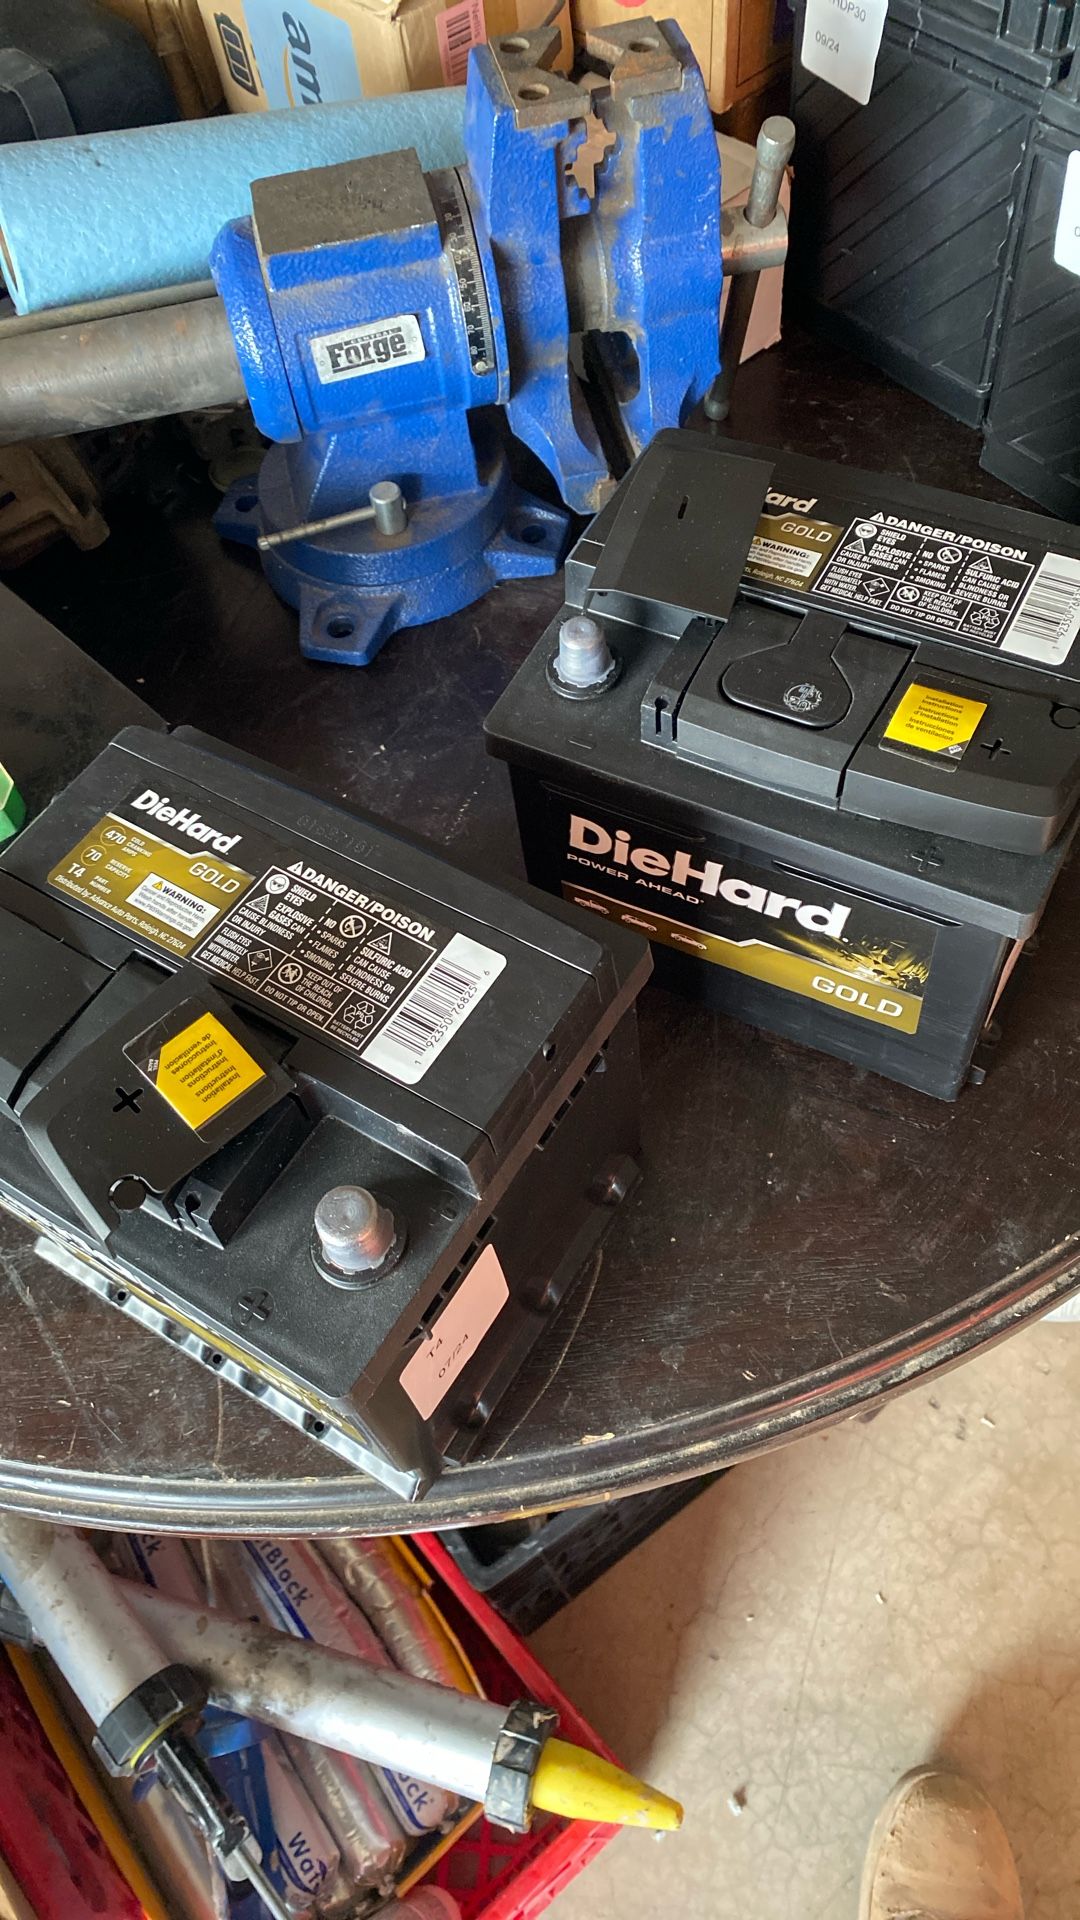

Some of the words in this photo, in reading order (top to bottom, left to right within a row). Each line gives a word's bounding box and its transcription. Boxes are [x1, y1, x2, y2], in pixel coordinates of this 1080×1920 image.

[815, 30, 840, 54] 09/24
[459, 277, 467, 289] 50
[467, 324, 476, 335] 70
[326, 333, 406, 369] Forge
[470, 345, 478, 354] 80
[765, 487, 818, 512] ard
[780, 522, 832, 542] GOLD
[876, 535, 897, 546] EYES
[880, 528, 907, 542] SHIELD
[885, 516, 1028, 560] DANGER/POISON
[762, 541, 810, 558] WARNING:
[868, 550, 893, 562] GASES
[892, 557, 908, 566] CAN
[872, 543, 914, 560] EXPLOSIVE
[922, 550, 935, 560] NO
[840, 550, 863, 560] CAUSE
[862, 556, 900, 572] BLINDNESS
[846, 558, 872, 570] INJURY
[922, 560, 950, 573] SPARKS
[824, 578, 840, 588] WITH
[830, 566, 849, 576] FLUSH
[848, 570, 863, 579] EYES
[914, 576, 947, 590] SMOKING
[919, 568, 946, 580] FLAMES
[964, 568, 1001, 584] SULFURIC
[1000, 579, 1020, 589] ACID
[958, 582, 998, 600] BLINDNESS
[996, 592, 1010, 602] OR
[962, 576, 977, 585] CAN
[976, 580, 1002, 592] CAUSE
[830, 586, 854, 598] MEDICAL
[854, 592, 869, 602] HELP
[866, 596, 883, 607] FAST.
[920, 596, 934, 604] THE
[932, 599, 956, 610] REACH
[923, 590, 940, 600] KEEP
[938, 594, 953, 603] OUT
[952, 598, 964, 606] OF
[954, 588, 982, 601] SEVERE
[982, 596, 1008, 608] BURNS
[890, 604, 902, 612] DO
[901, 606, 915, 615] NOT
[914, 610, 926, 618] TIP
[924, 613, 937, 622] OR
[936, 616, 956, 627] OPEN.
[918, 600, 928, 608] OF
[927, 604, 960, 617] CHILDREN.
[922, 700, 962, 714] Instructions
[926, 695, 964, 709] Installation
[914, 710, 958, 728] d'installation
[918, 706, 959, 721] Instructions
[130, 788, 243, 854] DieHard
[104, 830, 127, 845] 470
[131, 836, 146, 846] COLD
[84, 848, 102, 862] 70
[121, 846, 138, 857] AMPS
[68, 862, 86, 878] T4
[94, 876, 110, 885] PART
[104, 864, 130, 880] CAPACITY
[189, 862, 240, 894] GOLD
[566, 852, 630, 882] POWER
[635, 878, 702, 905] AHEAD
[568, 813, 852, 940] DieHard
[162, 886, 207, 914] WARNING:
[284, 892, 304, 907] EYES
[290, 884, 318, 902] SHIELD
[54, 874, 84, 894] Distributed
[90, 894, 112, 910] Advance
[110, 906, 126, 916] Auto
[138, 920, 160, 938] Raleigh,
[158, 931, 170, 942] NC
[166, 936, 187, 950] 27604
[274, 902, 316, 928] EXPLOSIVE
[300, 867, 436, 942] DANGER/POISON
[232, 914, 243, 924] OR
[240, 918, 267, 937] INJURY
[238, 906, 261, 922] CAUSE
[258, 918, 295, 940] BLINDNESS
[268, 910, 294, 927] GASES
[290, 922, 306, 934] CAN
[324, 918, 338, 930] NO
[214, 934, 249, 957] IMMEDIATELY
[220, 926, 240, 940] FLUSH
[236, 934, 252, 948] EYES
[320, 930, 348, 949] SPARKS
[206, 942, 223, 953] WITH
[220, 948, 240, 964] WATER.
[312, 940, 340, 959] FLAMES
[200, 950, 212, 960] GET
[209, 954, 232, 972] MEDICAL
[230, 966, 246, 978] HELP
[244, 972, 260, 987] FAST.
[303, 950, 336, 972] SMOKING
[353, 956, 370, 969] CAN
[368, 962, 392, 980] CAUSE
[360, 946, 396, 970] SULFURIC
[393, 964, 414, 980] ACID
[301, 978, 314, 989] THE
[311, 984, 334, 999] REACH
[306, 970, 322, 984] KEEP
[320, 976, 336, 990] OUT
[332, 984, 344, 994] OF
[339, 972, 366, 992] SEVERE
[364, 984, 390, 1004] BURNS
[346, 964, 384, 988] BLINDNESS
[382, 982, 396, 995] OR
[264, 985, 274, 996] DO
[273, 990, 288, 1004] NOT
[286, 997, 299, 1008] TIP
[296, 1002, 309, 1014] OR
[306, 1007, 325, 1024] OPEN.
[294, 984, 306, 994] OF
[303, 989, 334, 1010] CHILDREN.
[811, 975, 904, 1018] GOLD
[425, 1017, 454, 1048] 92350
[450, 984, 478, 1016] 76825
[202, 1032, 212, 1041] de
[164, 1040, 202, 1070] ventilacion
[180, 1048, 224, 1084] d'installation
[187, 1056, 229, 1088] Instructions
[194, 1065, 237, 1098] Instructions
[202, 1072, 241, 1103] Installation
[426, 1338, 444, 1358] T4
[438, 1334, 469, 1378] 07/24
[254, 1539, 309, 1608] rBlock
